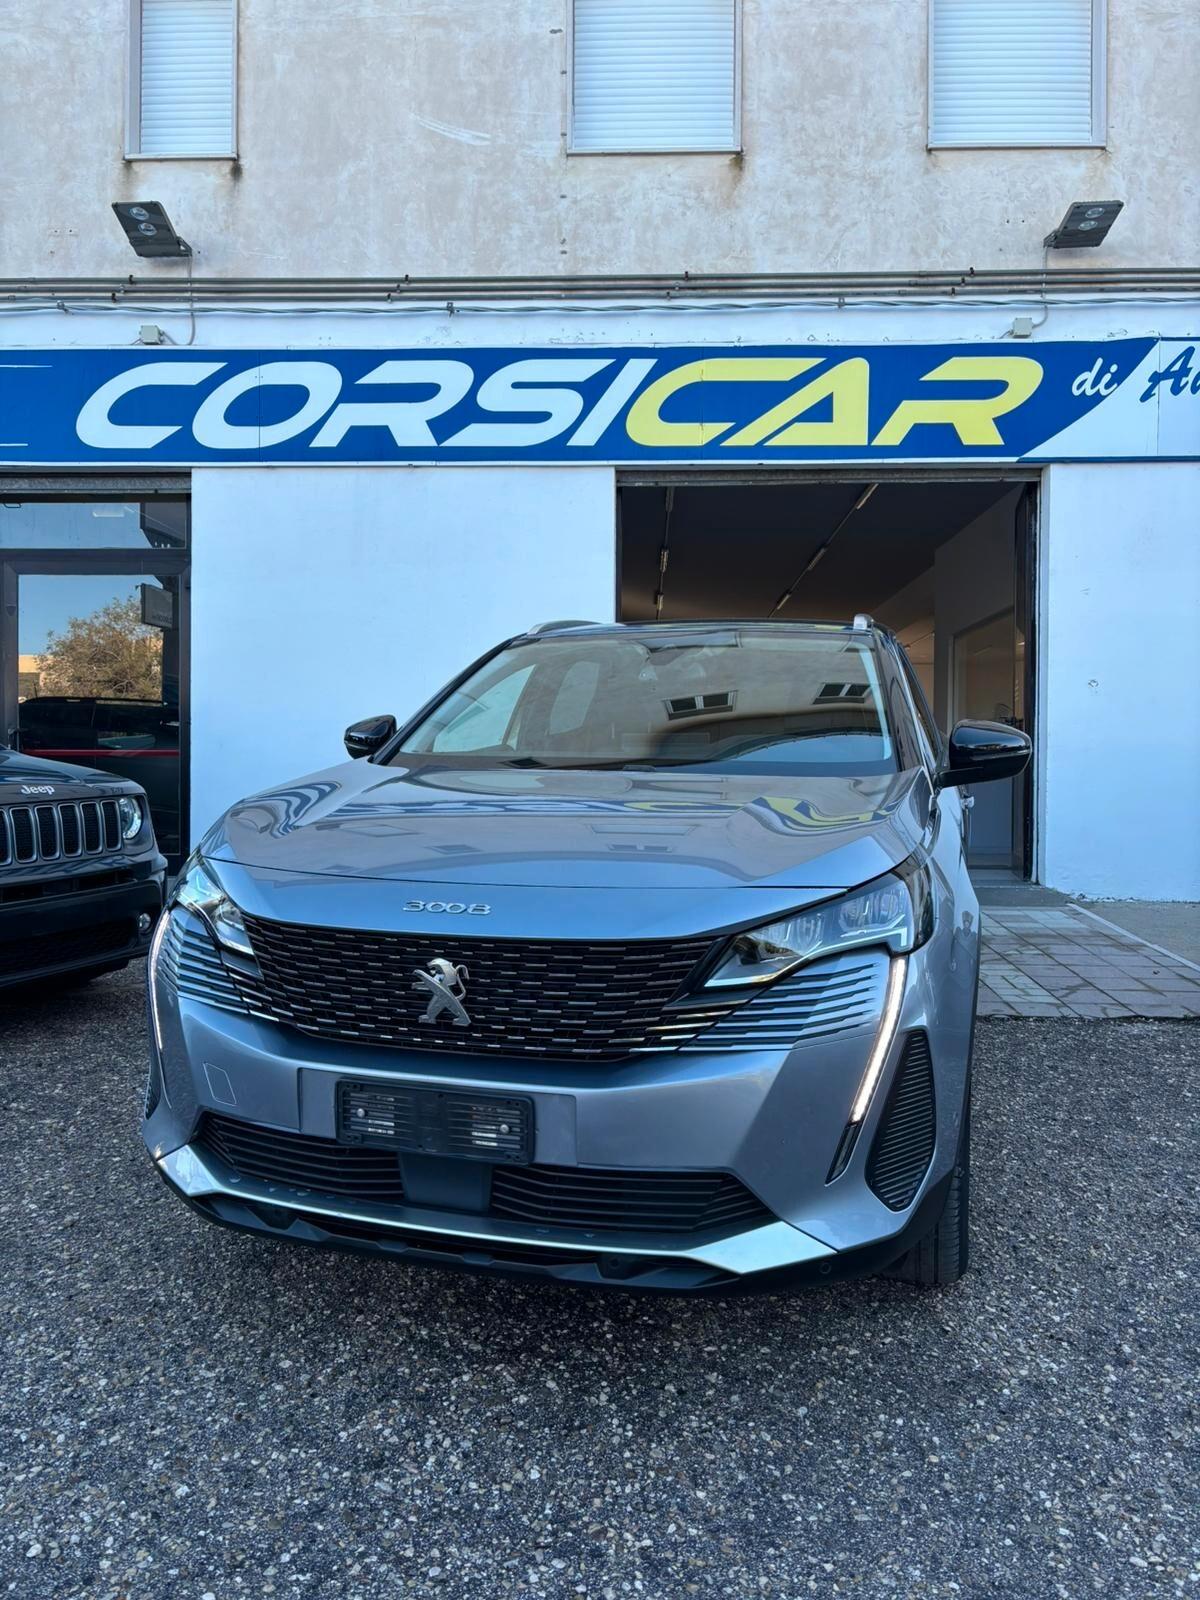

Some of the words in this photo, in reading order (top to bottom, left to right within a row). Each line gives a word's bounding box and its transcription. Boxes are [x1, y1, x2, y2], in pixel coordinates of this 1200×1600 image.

[76, 356, 1044, 449] CORSICAR
[1071, 357, 1118, 396] di
[20, 784, 55, 795] Jeep
[402, 900, 491, 915] 3008
